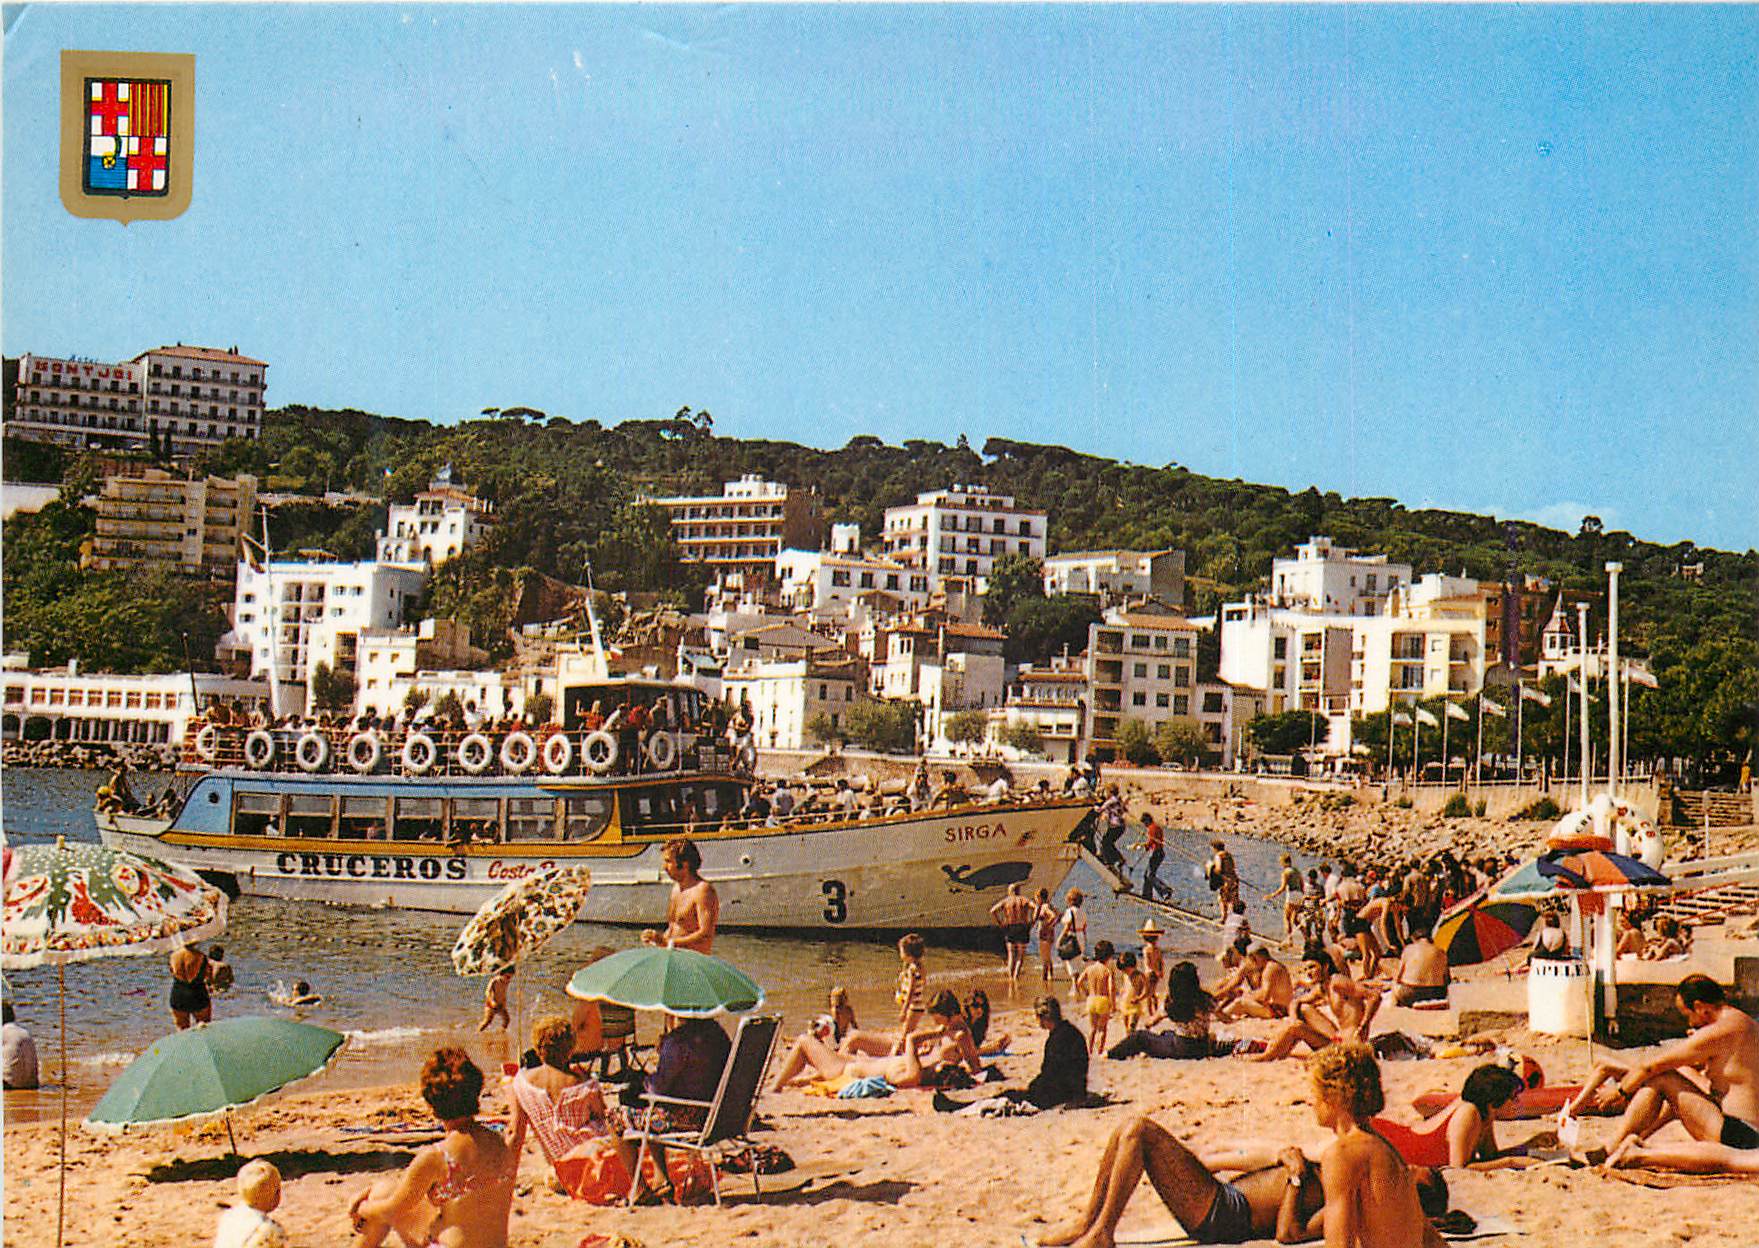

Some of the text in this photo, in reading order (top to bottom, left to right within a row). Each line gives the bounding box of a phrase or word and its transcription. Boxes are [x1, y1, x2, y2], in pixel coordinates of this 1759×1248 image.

[945, 823, 1007, 842] SIRGA
[276, 852, 467, 880] CRUCEROS
[822, 880, 847, 923] 3
